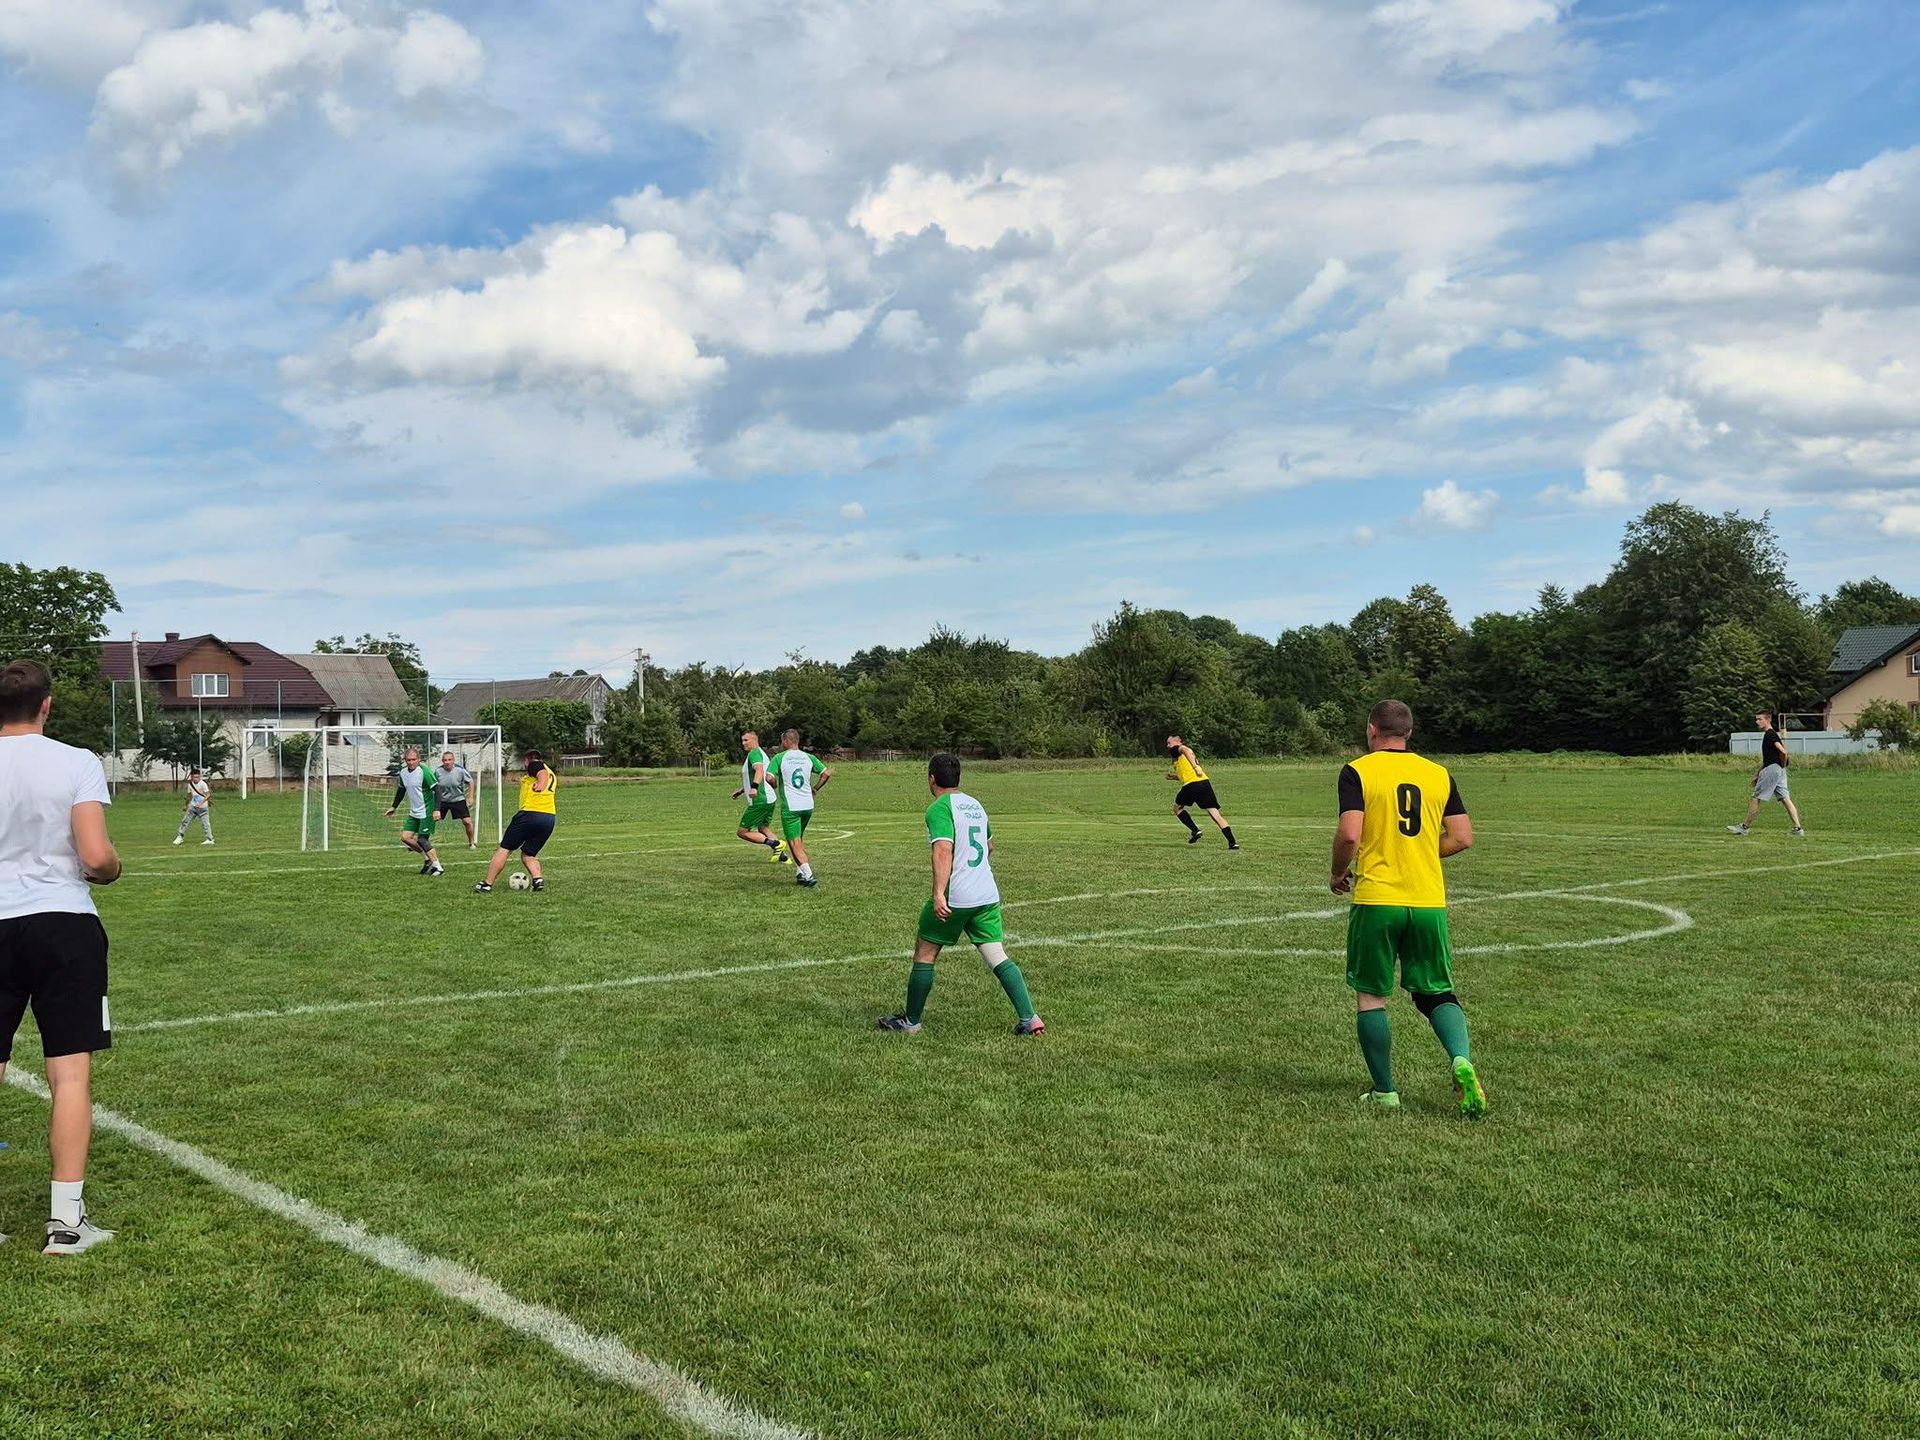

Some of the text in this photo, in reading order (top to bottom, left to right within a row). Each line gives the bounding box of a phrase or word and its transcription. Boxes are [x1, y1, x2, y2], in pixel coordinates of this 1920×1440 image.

[791, 768, 805, 789] 6
[1397, 783, 1422, 837] 9
[967, 826, 984, 867] 5
